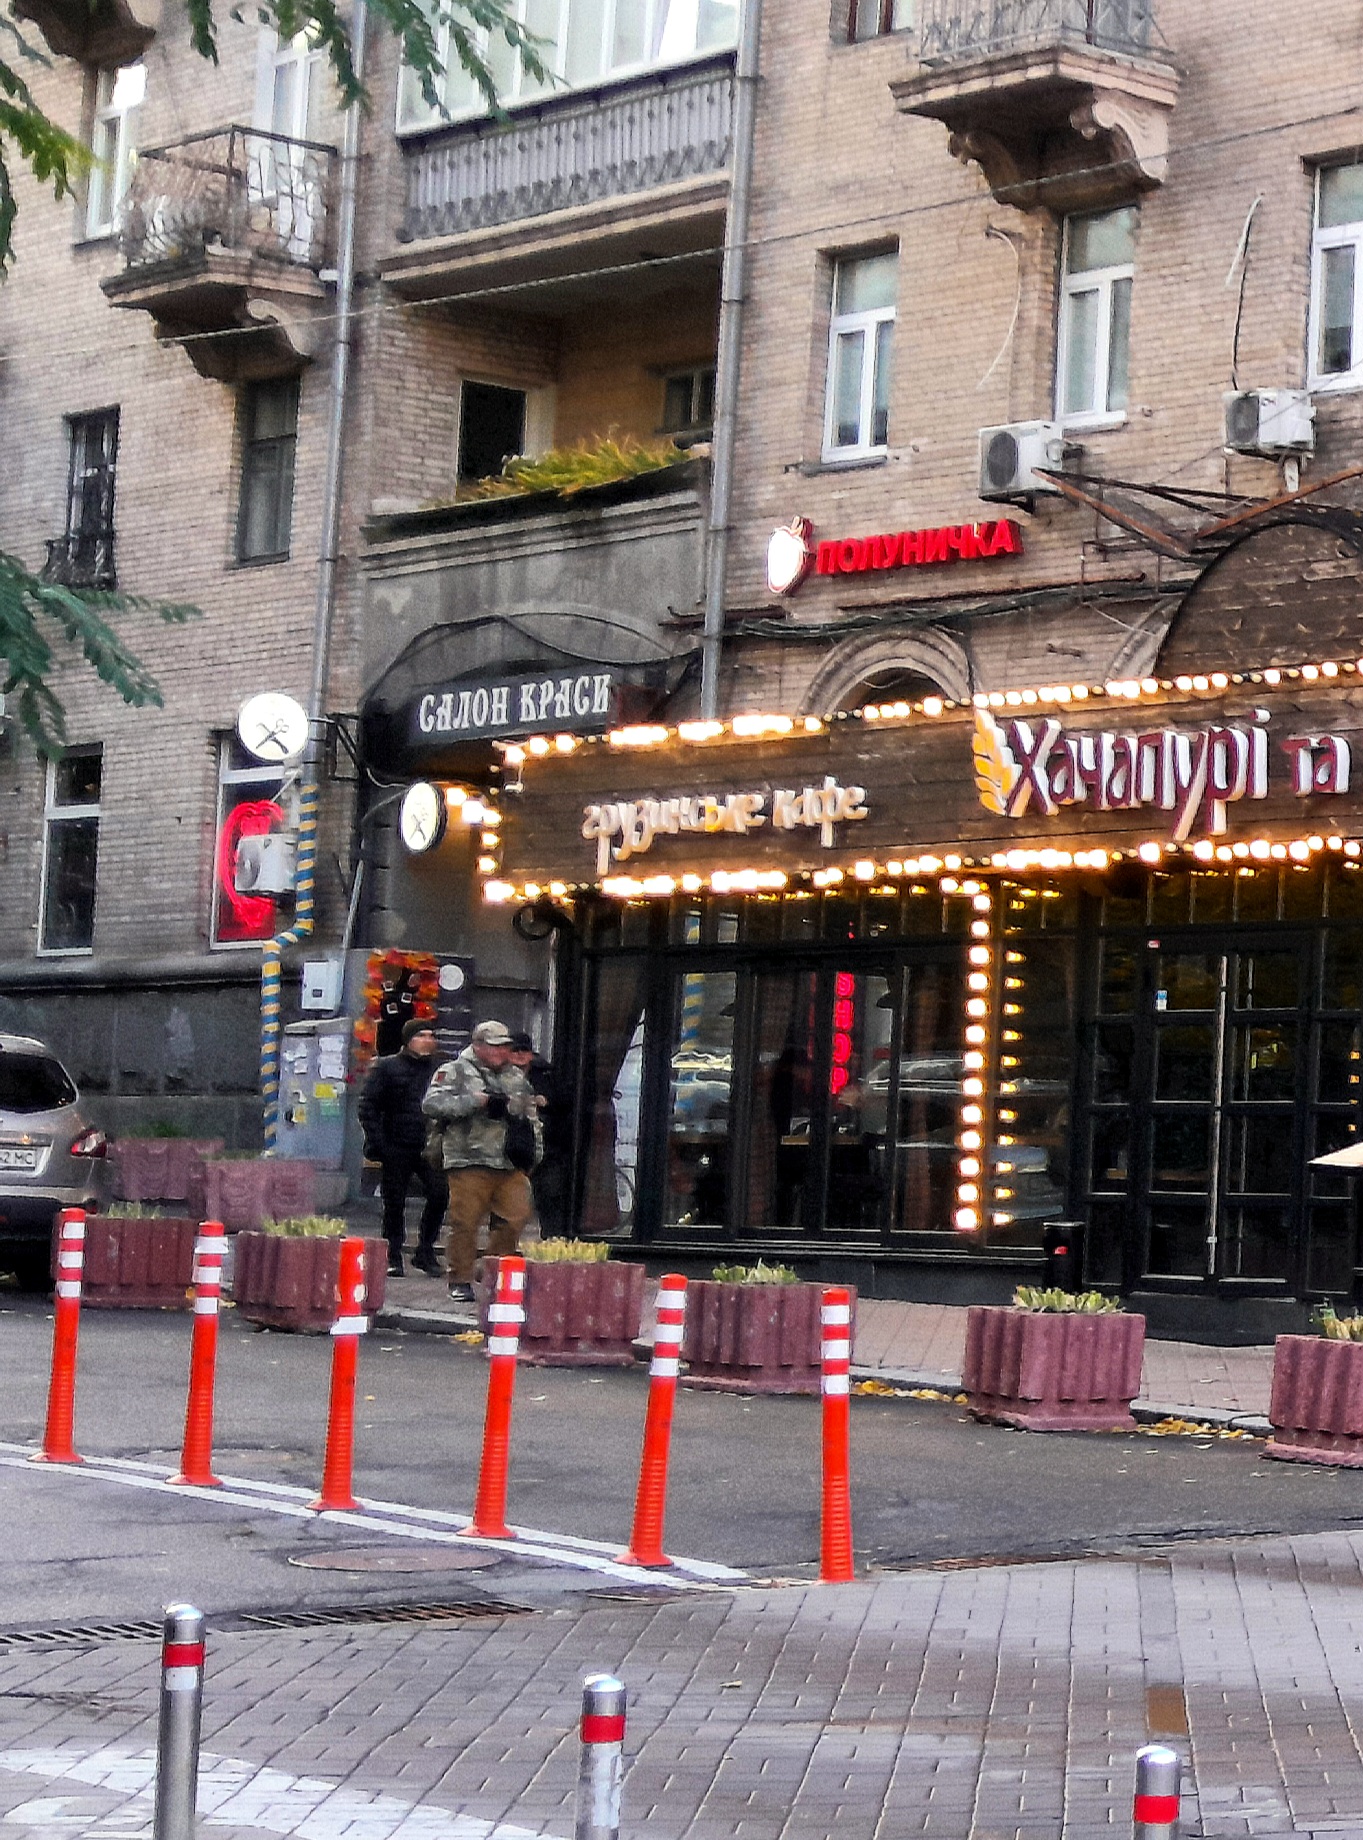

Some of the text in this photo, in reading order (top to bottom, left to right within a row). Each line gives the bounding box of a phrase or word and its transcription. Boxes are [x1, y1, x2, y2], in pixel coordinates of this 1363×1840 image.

[816, 519, 1022, 574] ПОЛУНИЧКА
[419, 673, 612, 733] САЛОН КРАСИ
[1003, 707, 1271, 840] Хачапурі
[1281, 733, 1351, 797] та
[772, 774, 870, 848] кафе
